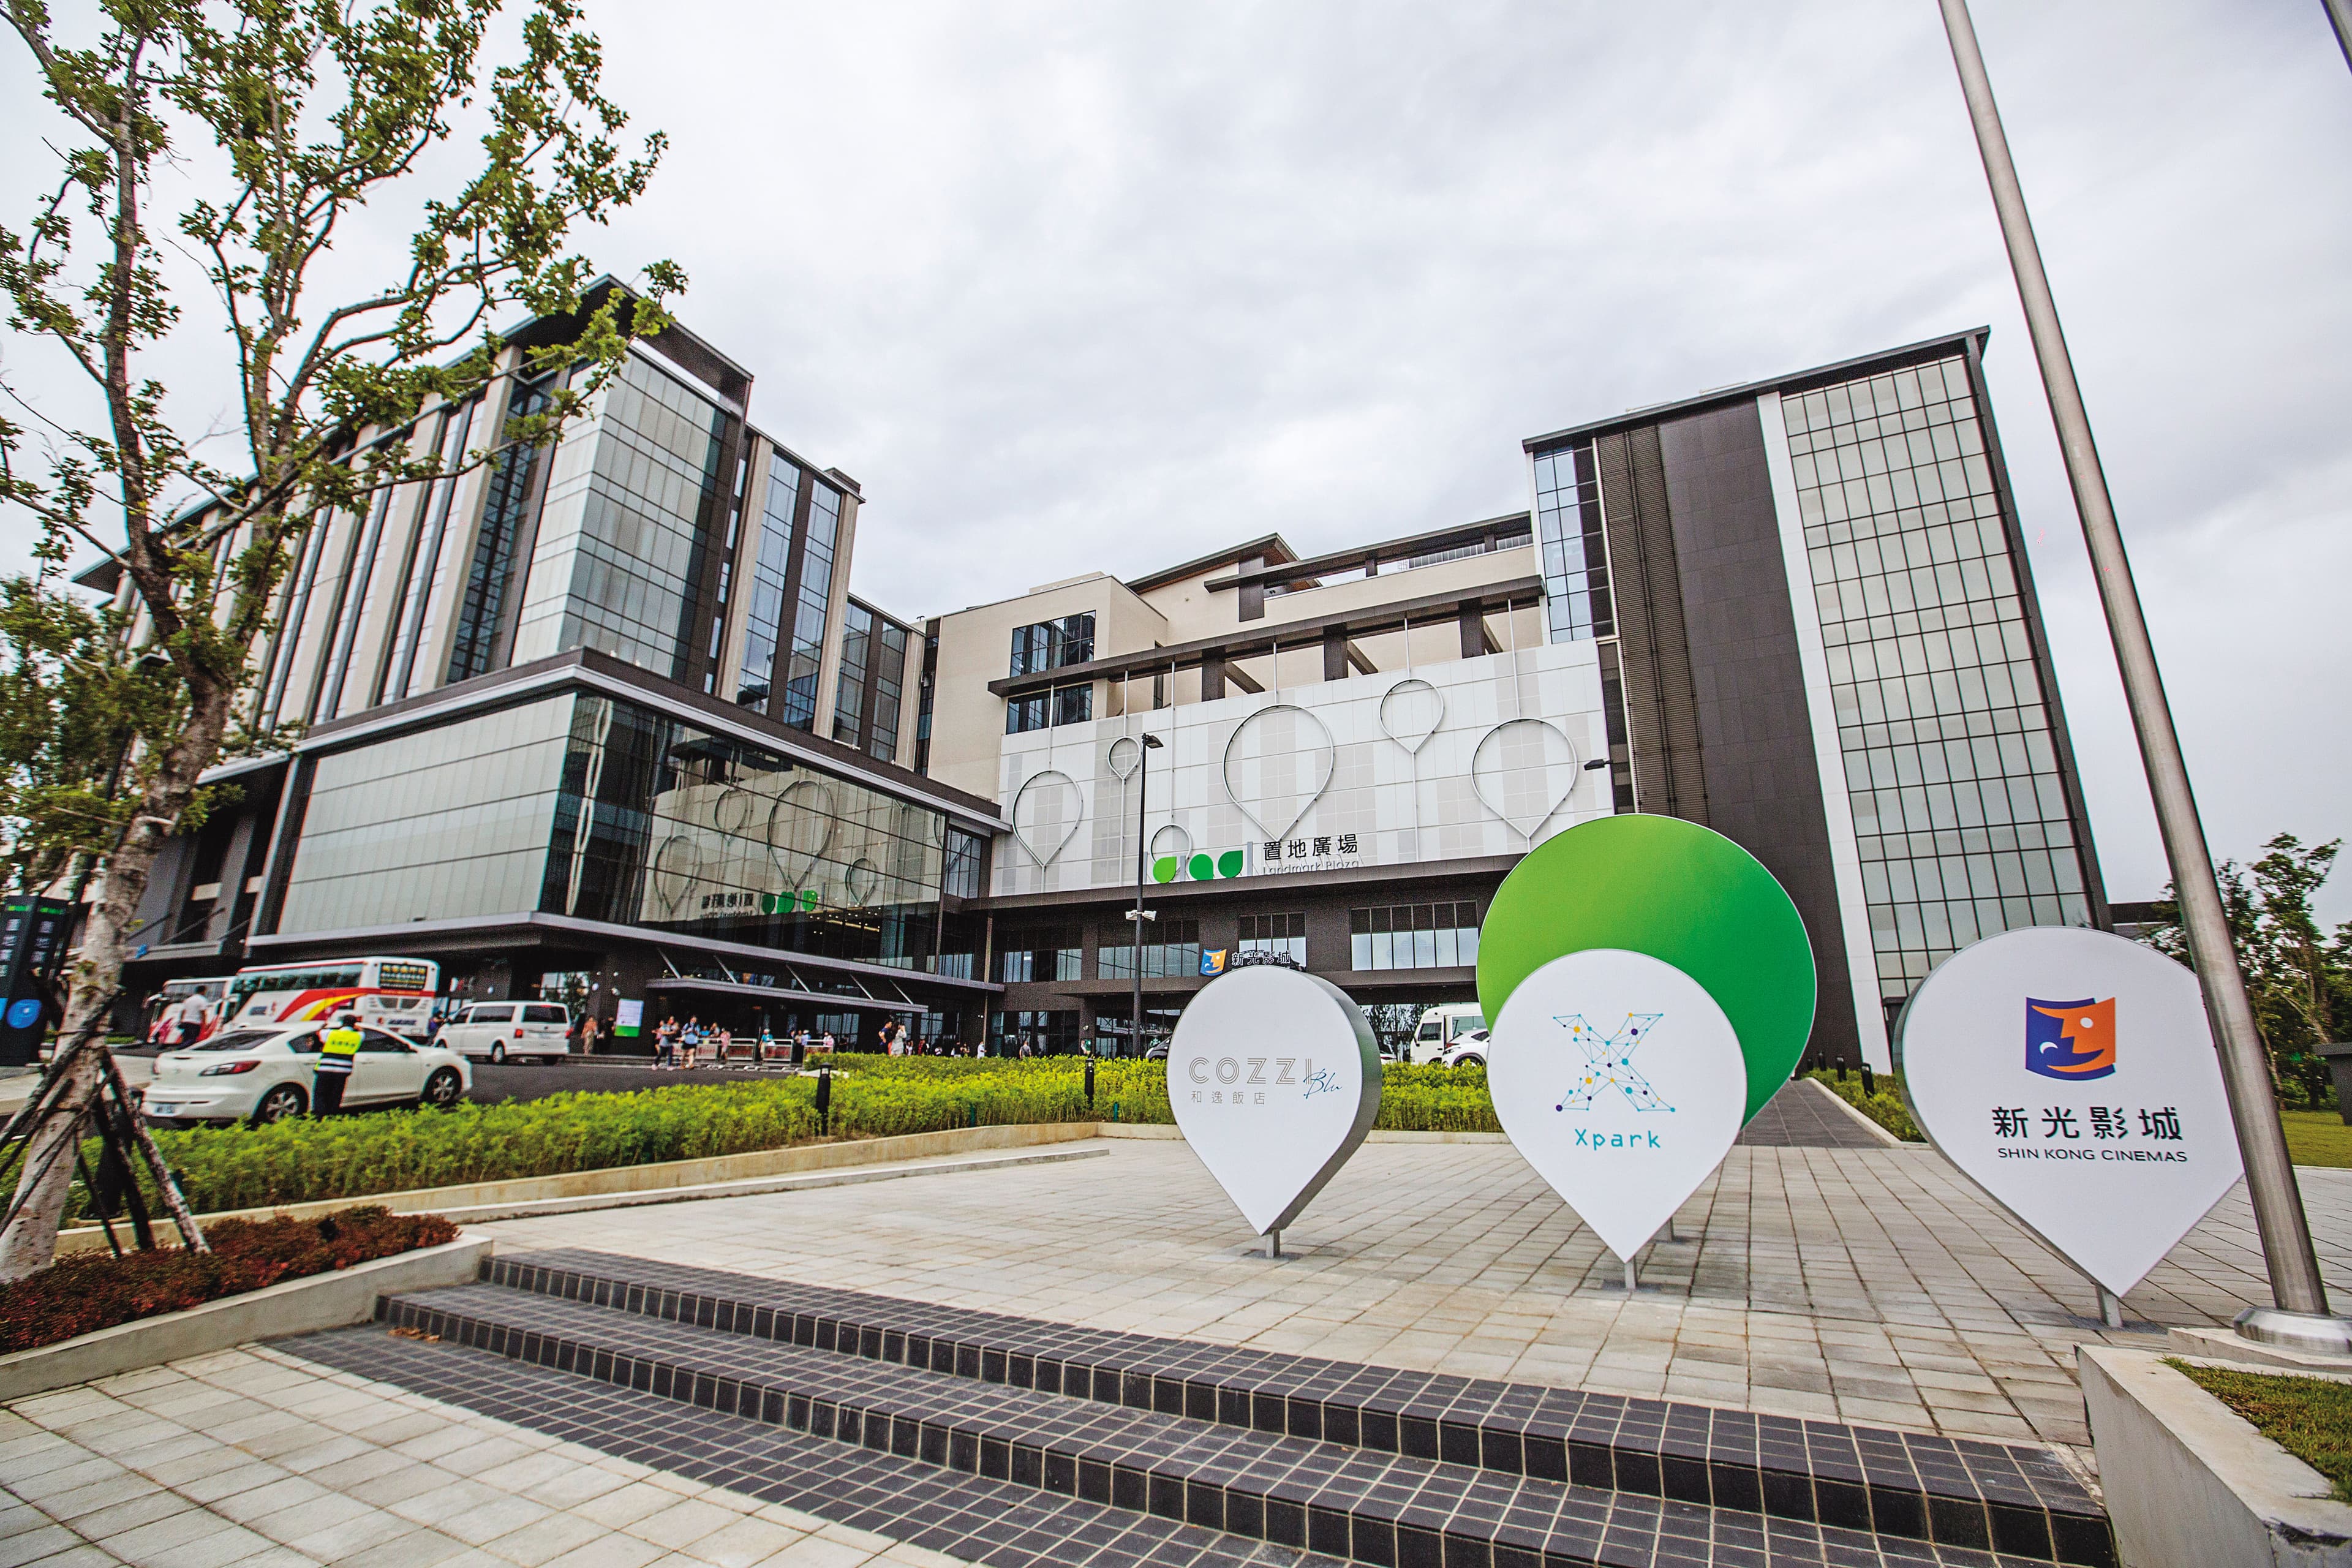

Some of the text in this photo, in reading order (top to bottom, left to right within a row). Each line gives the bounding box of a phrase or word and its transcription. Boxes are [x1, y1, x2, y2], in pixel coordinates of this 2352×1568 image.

[1263, 834, 1358, 861] 置地廣場
[1232, 951, 1291, 966] 新光影城
[1189, 1057, 1342, 1099] COZZI Blu
[1191, 1090, 1265, 1105] 和逸飯店
[1991, 1106, 2184, 1140] 新光影城
[1575, 1128, 1661, 1150] Xpark
[1997, 1148, 2188, 1163] SHIN KONG CINEMAS
